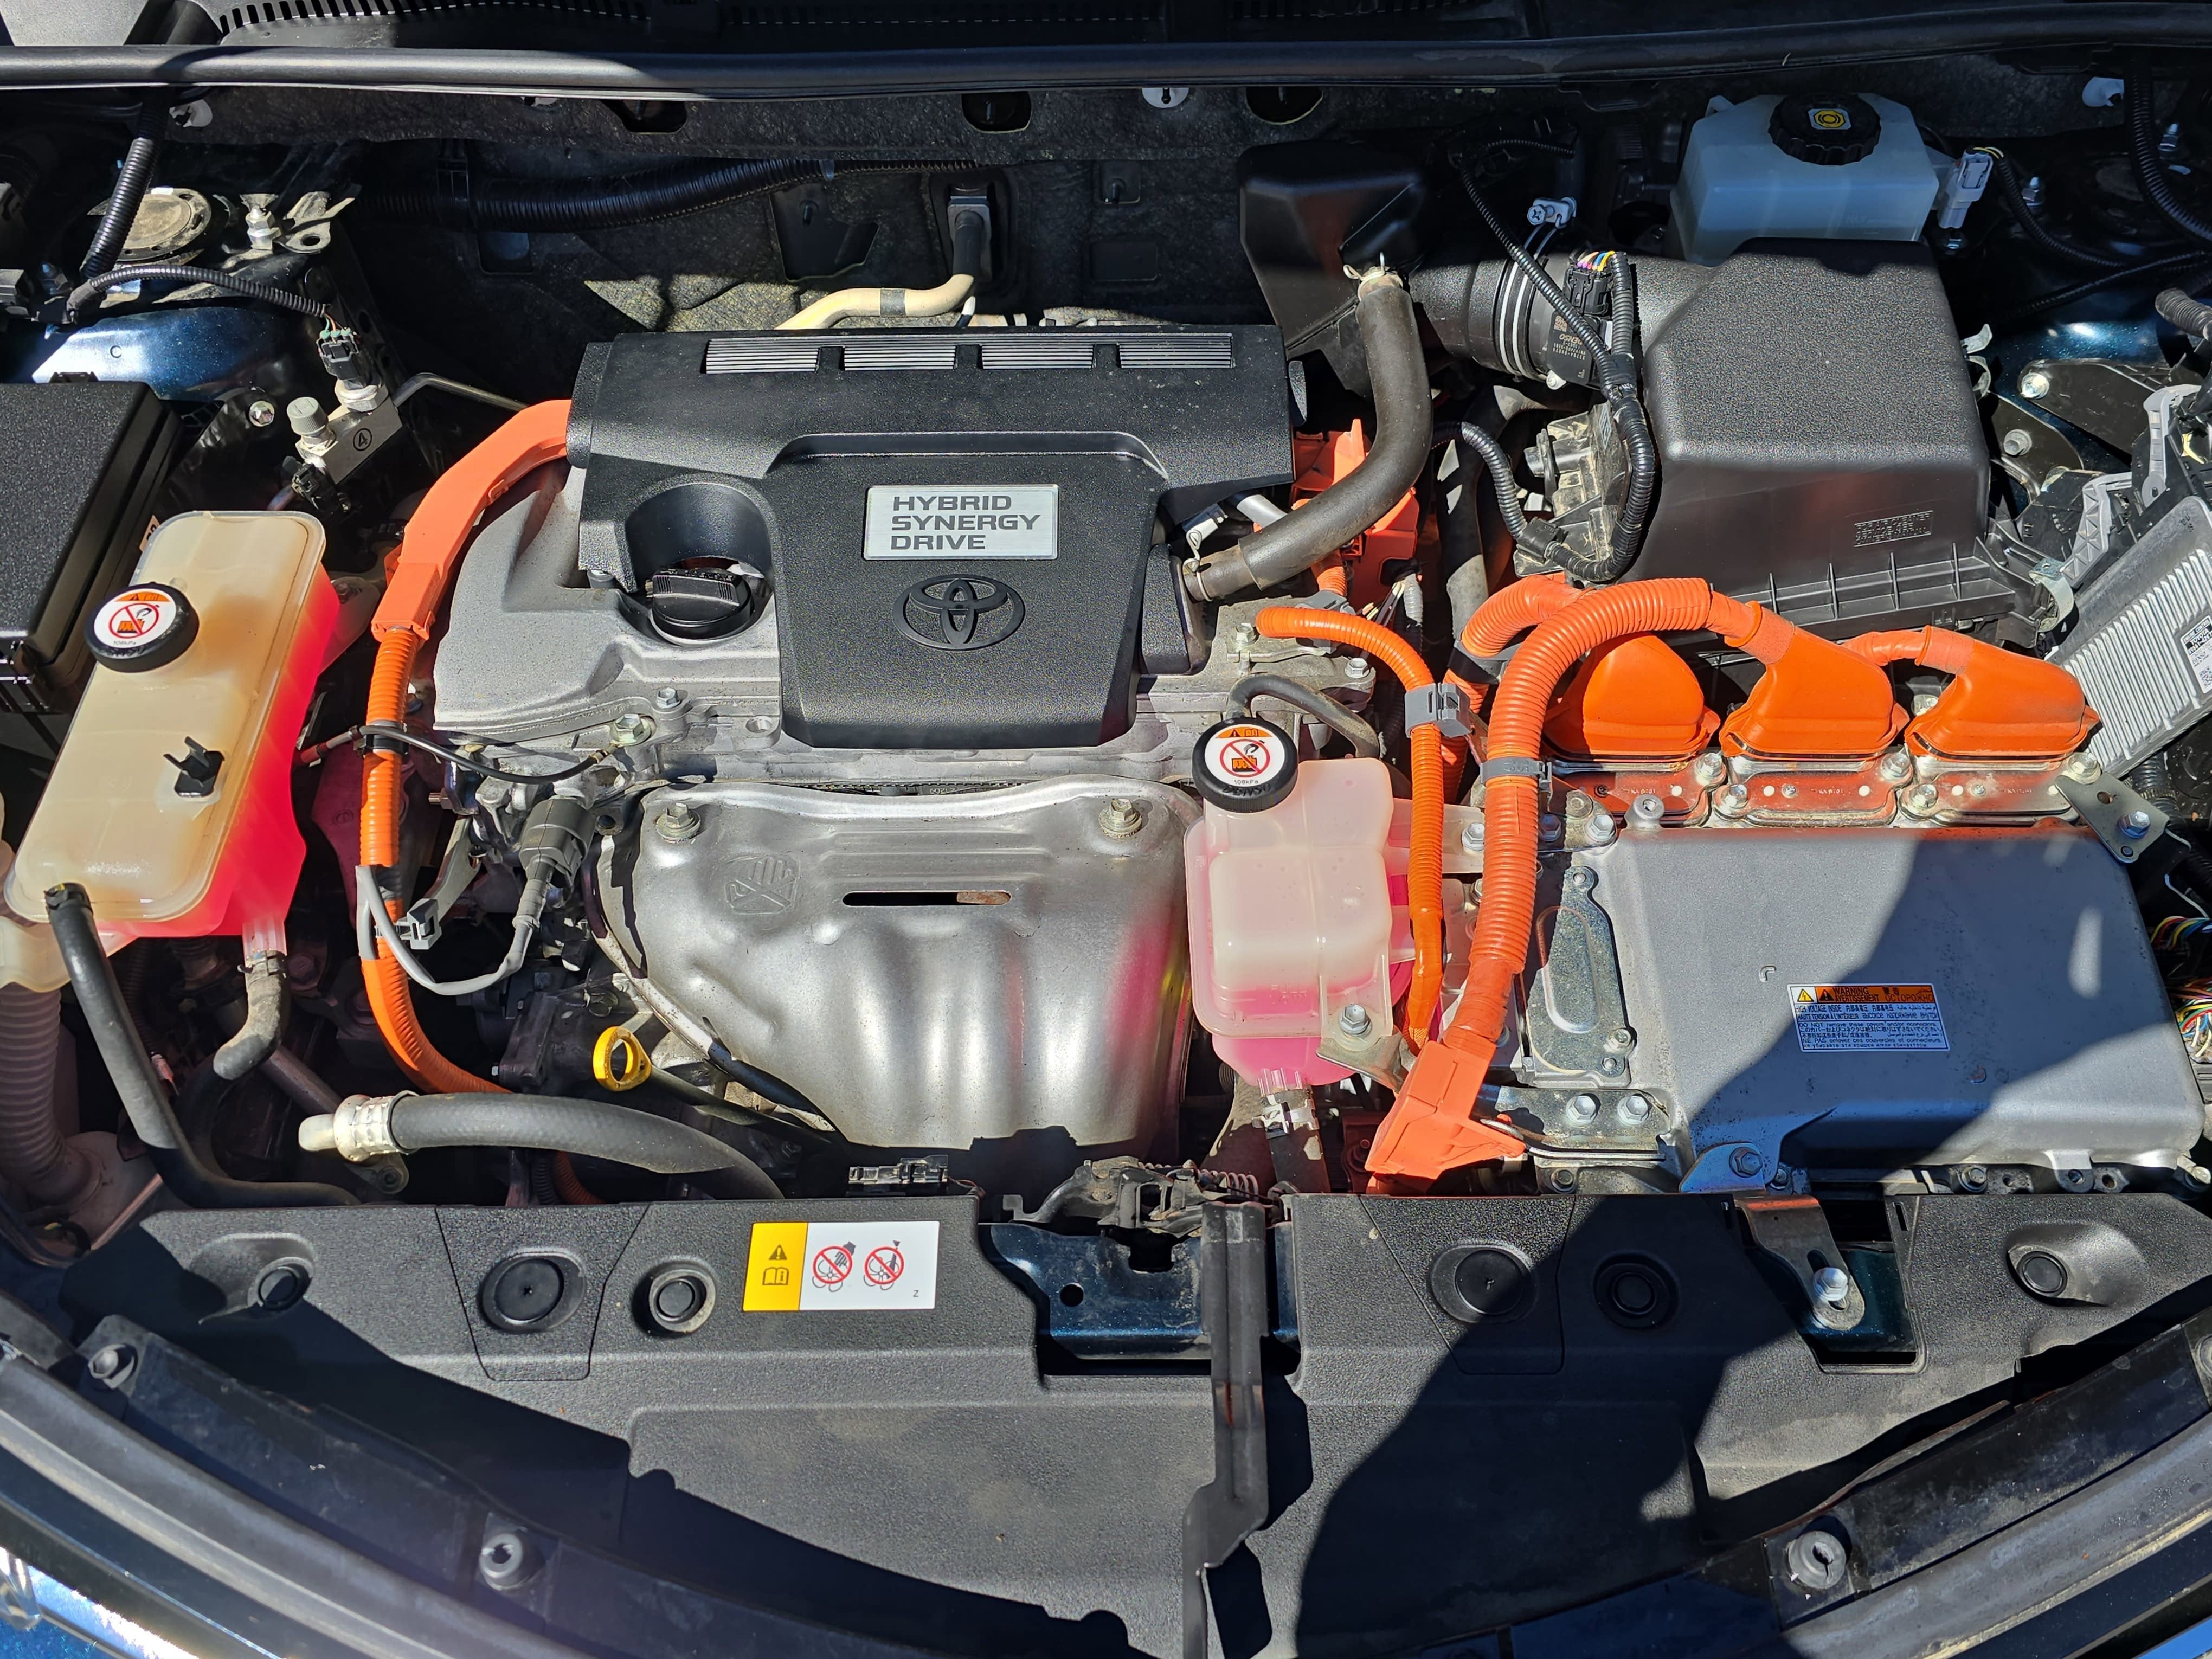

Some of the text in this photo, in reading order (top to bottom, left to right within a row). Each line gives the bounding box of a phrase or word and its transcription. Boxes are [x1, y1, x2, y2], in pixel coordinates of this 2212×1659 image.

[1559, 333, 1583, 345] DENSO
[893, 496, 1012, 511] HYBRID
[891, 515, 1040, 530] SYNERGY
[891, 535, 986, 550] DRIVE
[2191, 628, 2208, 646] TOYOTA
[1222, 783, 1271, 797] DENSO
